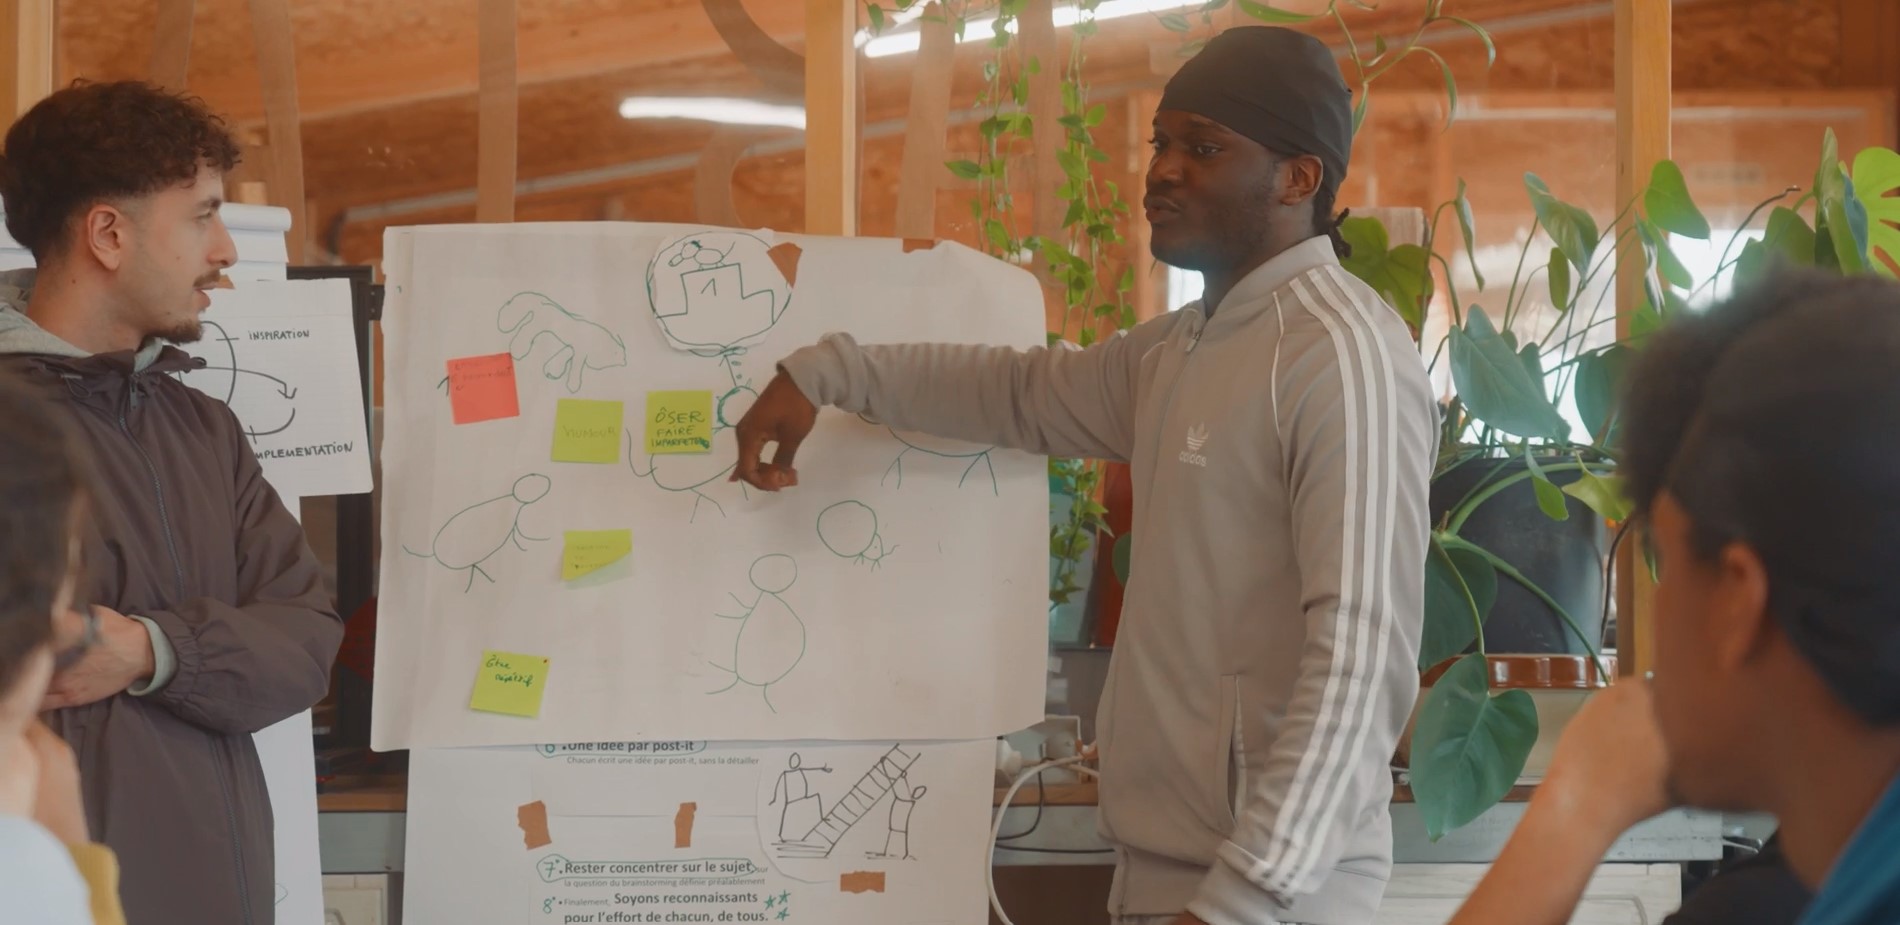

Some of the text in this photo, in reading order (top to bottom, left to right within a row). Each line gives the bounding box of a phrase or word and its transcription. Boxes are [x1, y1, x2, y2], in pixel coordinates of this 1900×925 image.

[249, 329, 310, 341] INSPIRATION
[655, 406, 706, 425] ÔSER
[255, 441, 353, 461] MPLEMENTATION
[628, 741, 648, 753] par
[653, 741, 694, 753] post-it
[567, 756, 596, 764] Chacun
[598, 756, 616, 764] écrit
[634, 756, 651, 764] idée
[653, 758, 667, 766] par
[699, 757, 717, 765] sans
[718, 756, 725, 764] la
[727, 756, 759, 765] détailler
[565, 863, 605, 873] Rester
[609, 862, 678, 873] concentrer
[682, 863, 702, 873] sur
[705, 861, 716, 872] le
[573, 880, 608, 888] question
[610, 879, 619, 887] du
[622, 879, 678, 888] brainstorming
[679, 879, 706, 887] définie
[708, 878, 765, 887] préalablement
[614, 893, 659, 906] Soyons
[663, 892, 758, 904] reconnaissants
[564, 914, 595, 925] pour
[646, 911, 661, 923] de
[665, 911, 714, 924] chacun,
[717, 910, 733, 922] de
[737, 912, 769, 922] tous.
